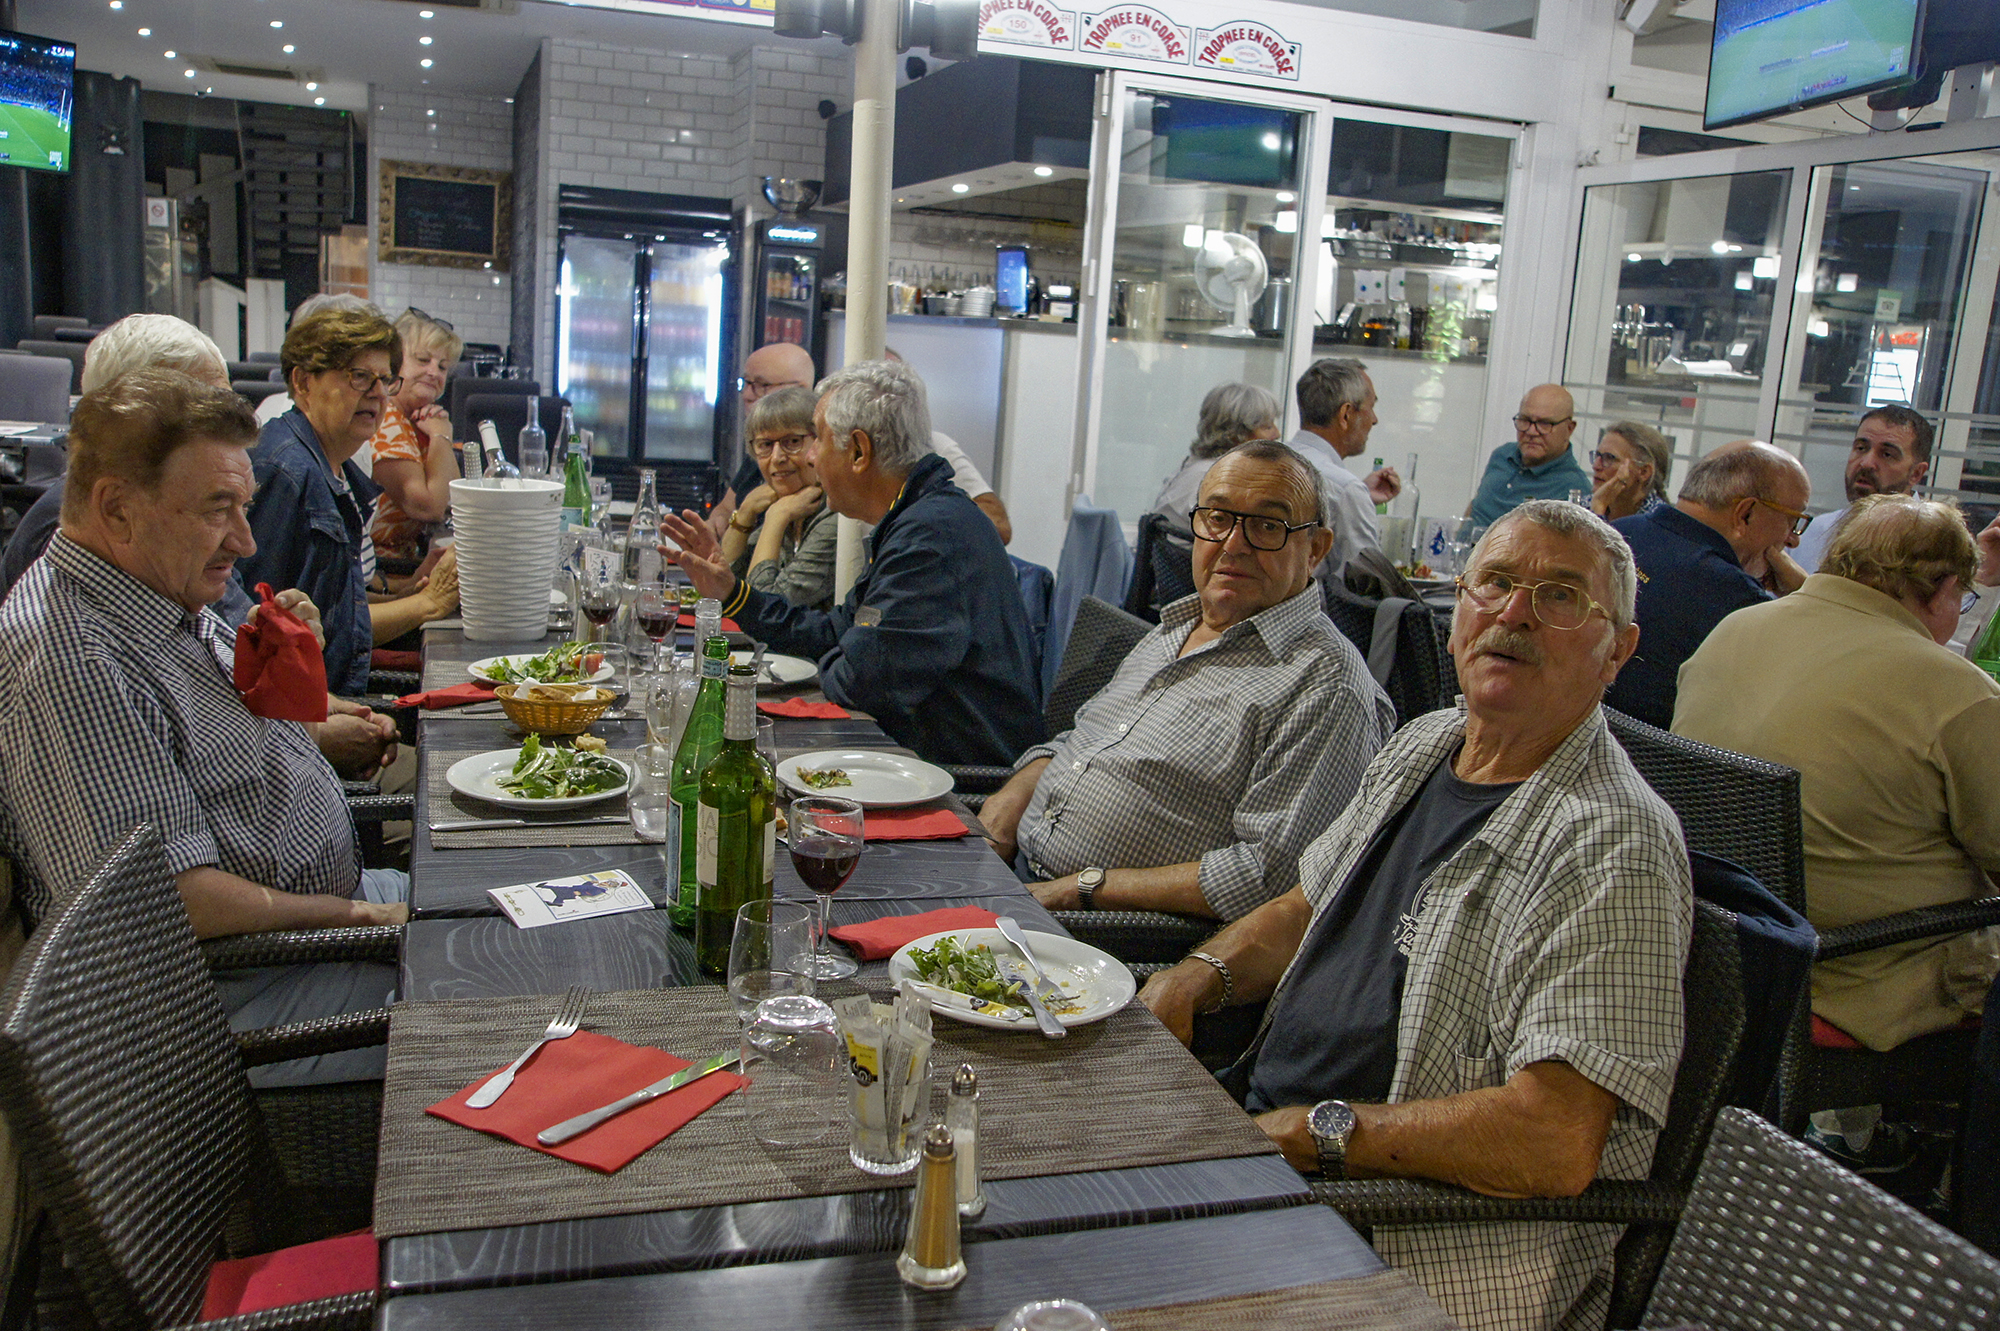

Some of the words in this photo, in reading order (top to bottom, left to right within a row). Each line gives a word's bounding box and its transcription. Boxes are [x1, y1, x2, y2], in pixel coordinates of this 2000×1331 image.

[978, 0, 1015, 35] OPHEE
[1017, 0, 1034, 12] EN
[1033, 4, 1069, 45] CORSE
[1010, 20, 1027, 29] 150
[1084, 12, 1133, 50] TROPHEE
[1135, 12, 1152, 27] EN
[1151, 19, 1185, 59] CORSE
[1130, 34, 1141, 42] 91
[1198, 28, 1245, 65] TROPHEE
[1248, 28, 1264, 44] EN
[1262, 36, 1294, 75] CORSE
